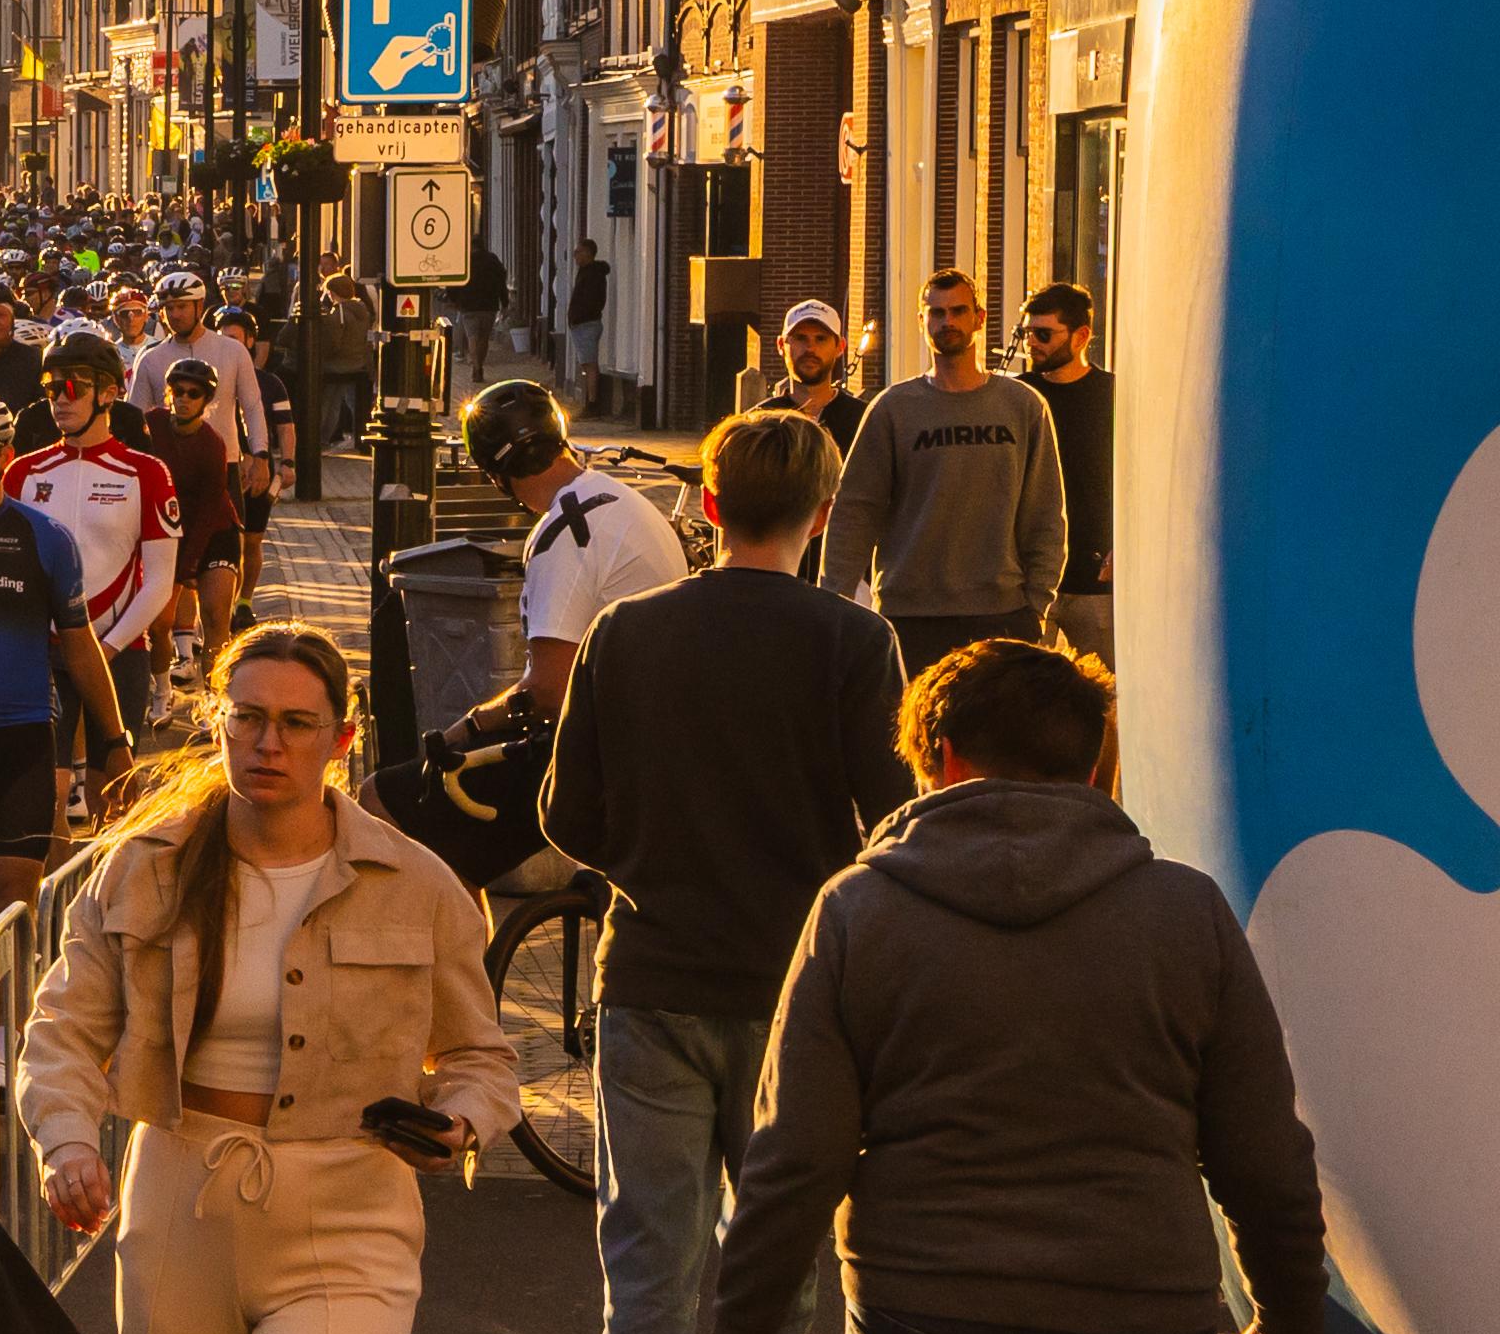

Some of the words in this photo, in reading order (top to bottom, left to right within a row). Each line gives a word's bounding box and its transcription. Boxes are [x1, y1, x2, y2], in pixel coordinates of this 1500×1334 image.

[335, 118, 460, 140] gehandicapten
[377, 141, 407, 160] vrij
[423, 216, 437, 238] 6
[913, 425, 1016, 451] MIRKA
